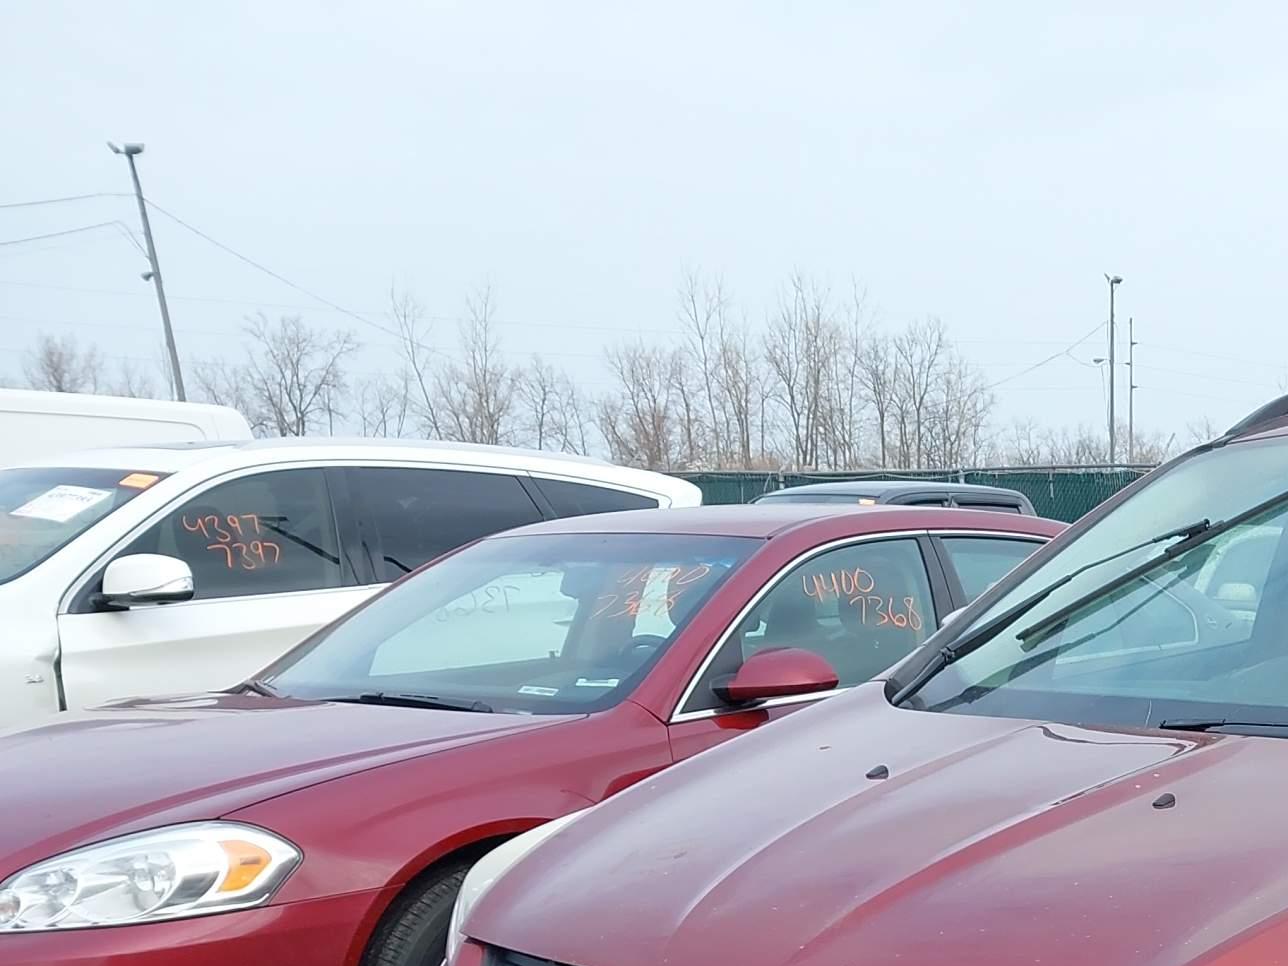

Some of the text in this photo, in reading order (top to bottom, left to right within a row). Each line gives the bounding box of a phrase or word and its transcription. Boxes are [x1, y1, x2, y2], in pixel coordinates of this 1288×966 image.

[182, 515, 260, 542] 4397
[206, 540, 280, 570] 7397
[802, 567, 875, 603] 4400
[848, 595, 922, 631] 7368
